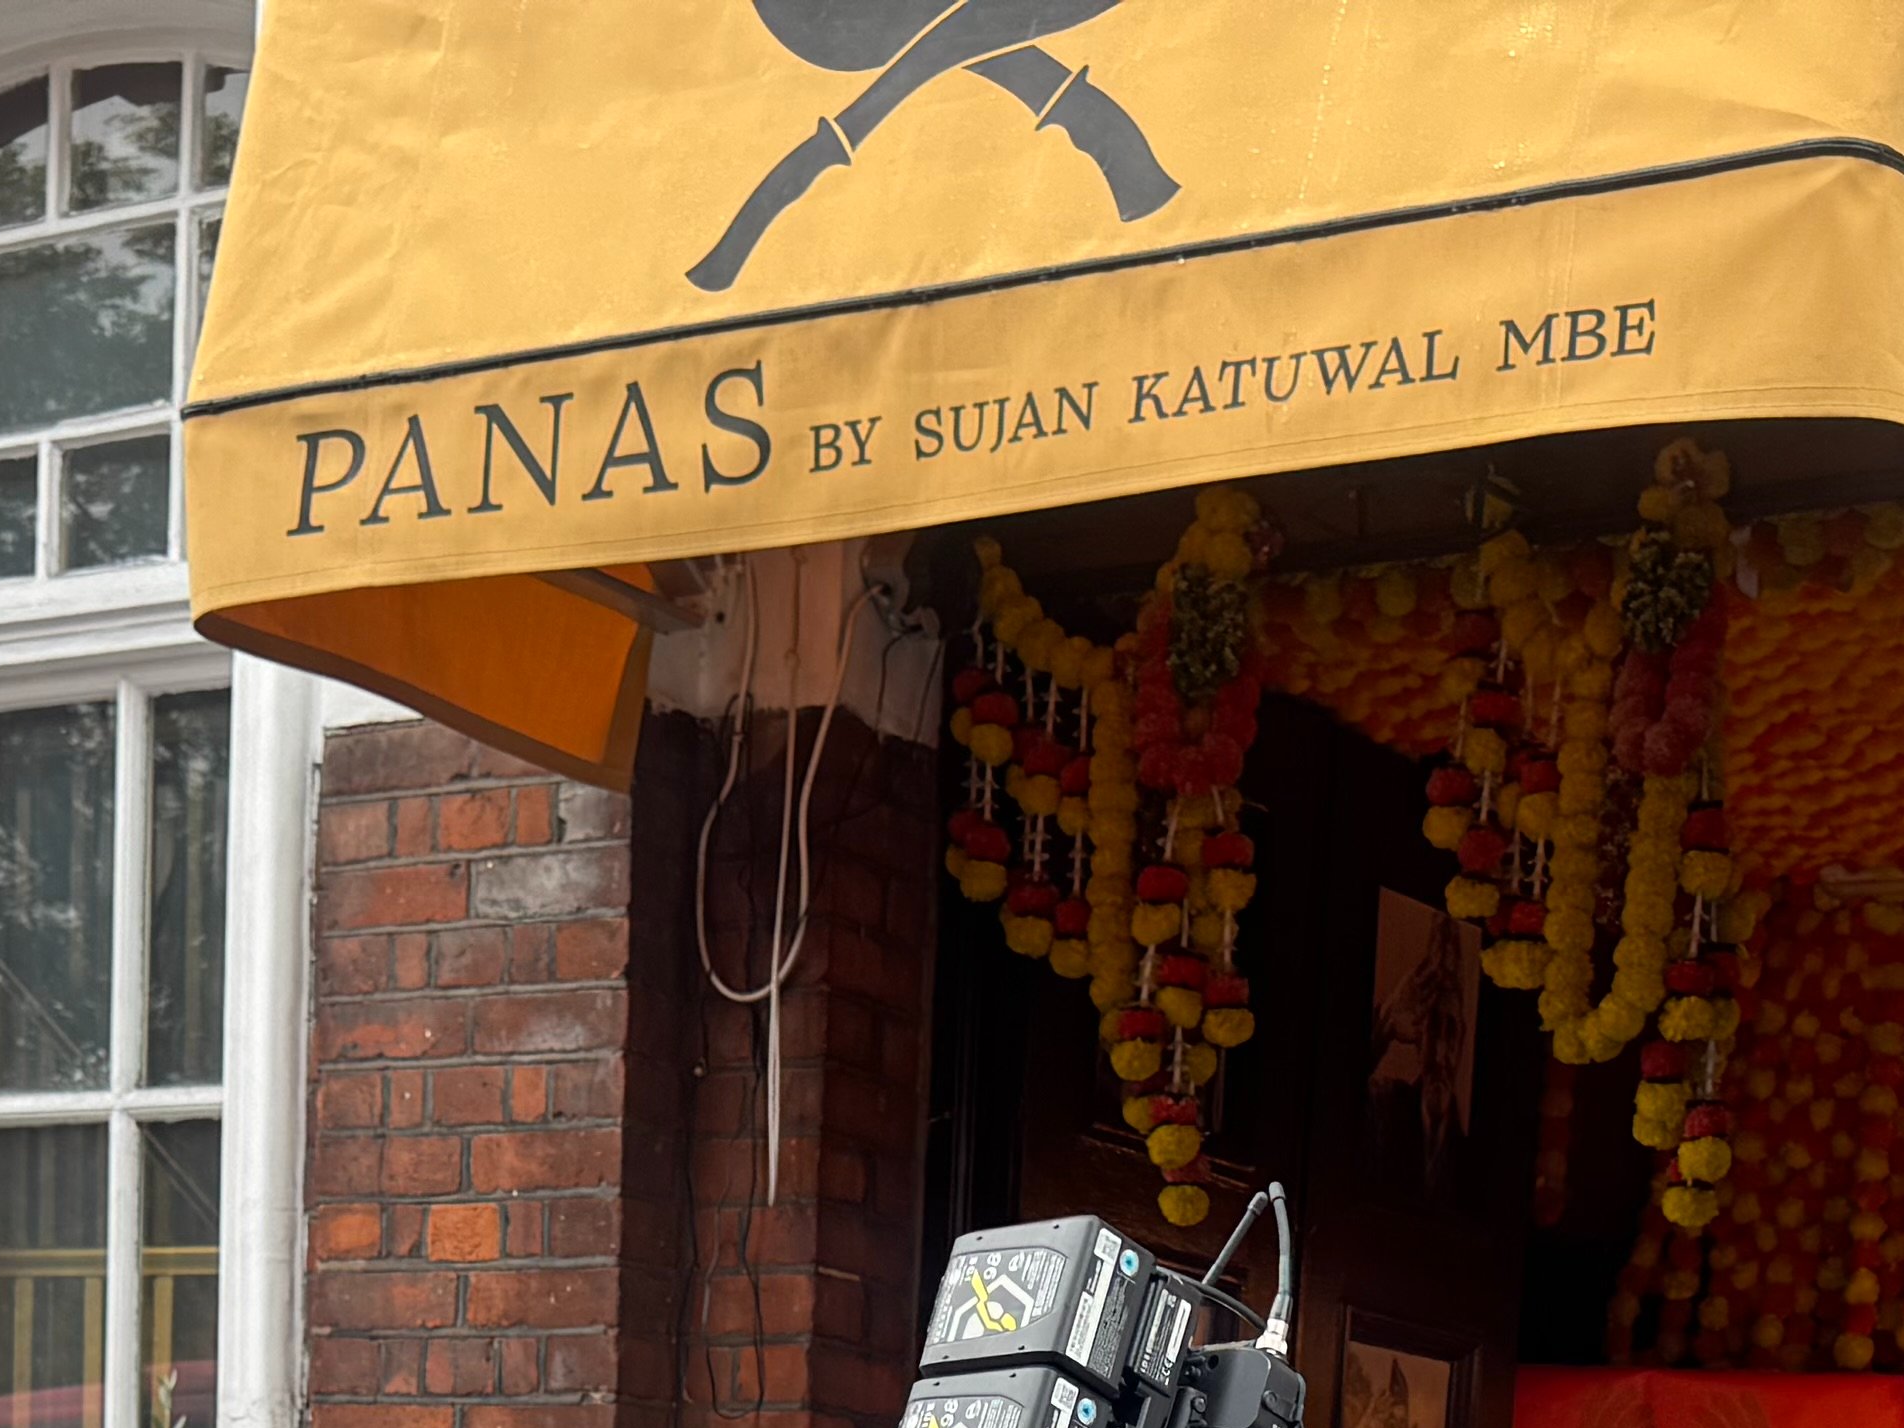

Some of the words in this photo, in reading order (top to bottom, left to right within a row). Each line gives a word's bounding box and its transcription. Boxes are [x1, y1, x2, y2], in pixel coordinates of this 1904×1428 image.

[286, 359, 772, 537] PANAS
[809, 415, 882, 474] BY
[914, 381, 1100, 461] SUJAN
[1127, 329, 1459, 424] KATUWAL
[1496, 298, 1658, 372] MBE
